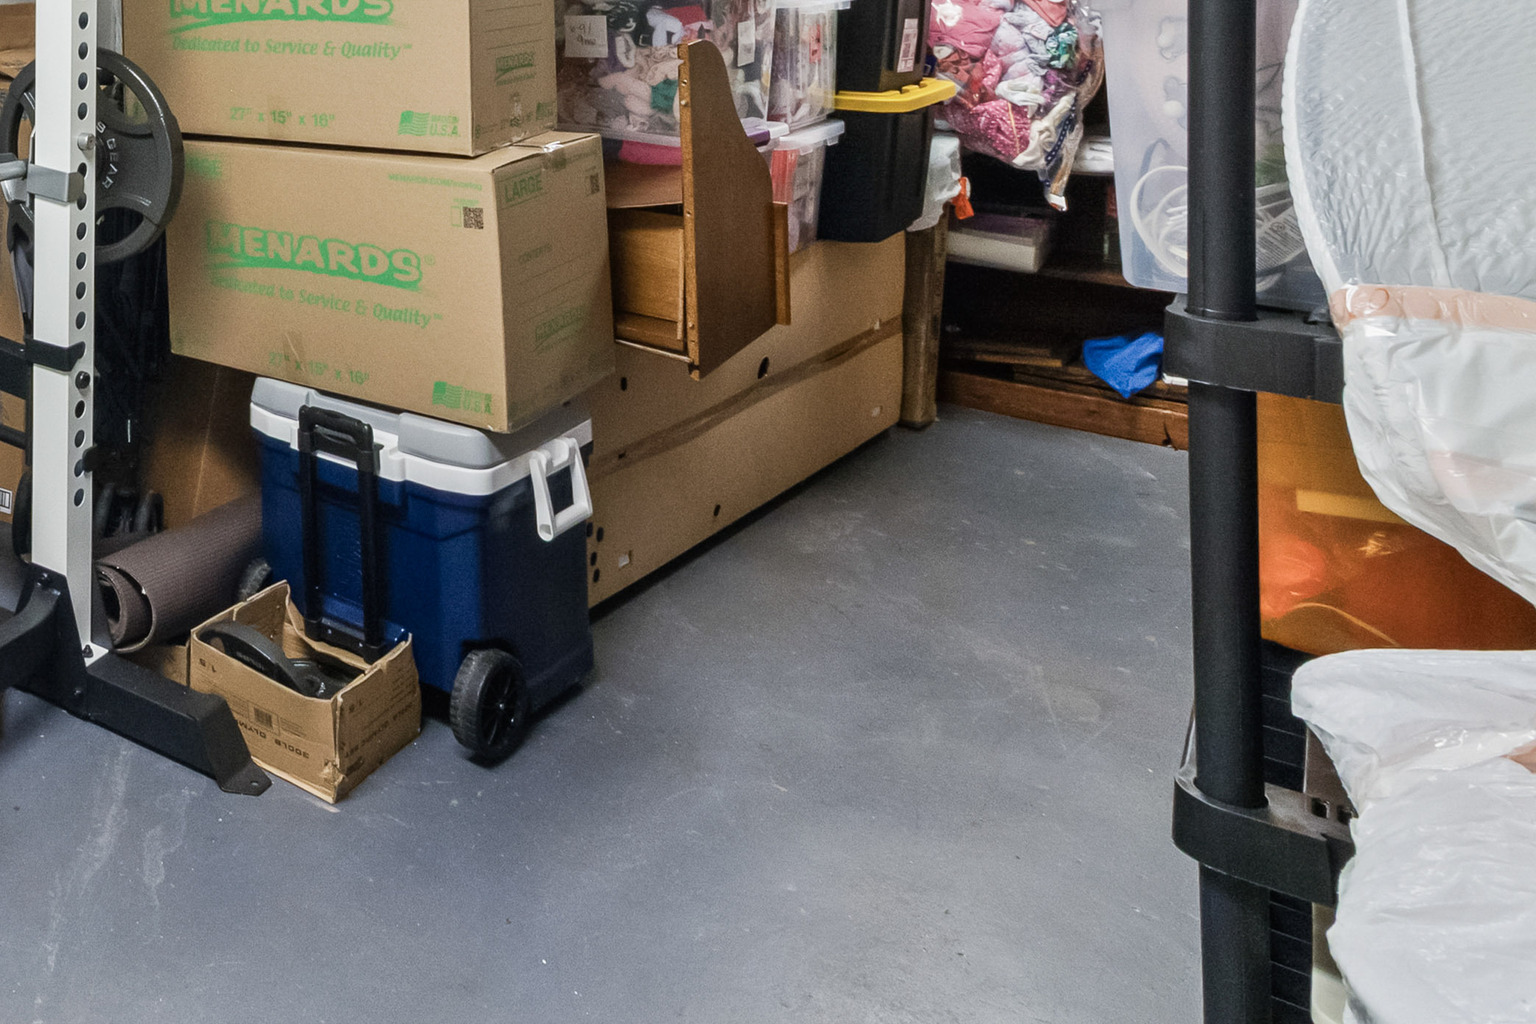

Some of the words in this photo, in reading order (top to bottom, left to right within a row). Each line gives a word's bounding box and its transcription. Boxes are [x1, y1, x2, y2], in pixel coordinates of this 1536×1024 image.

[244, 39, 260, 53] to
[265, 38, 318, 55] Service
[323, 41, 336, 56] &
[341, 41, 400, 60] Quality
[270, 109, 292, 124] 15"
[505, 175, 543, 203] LARGE
[206, 221, 423, 284] MENARDS
[279, 285, 295, 301] to
[299, 289, 351, 312] Service
[355, 299, 368, 315] &
[372, 303, 431, 328] Quality
[238, 721, 266, 738] OLYM
